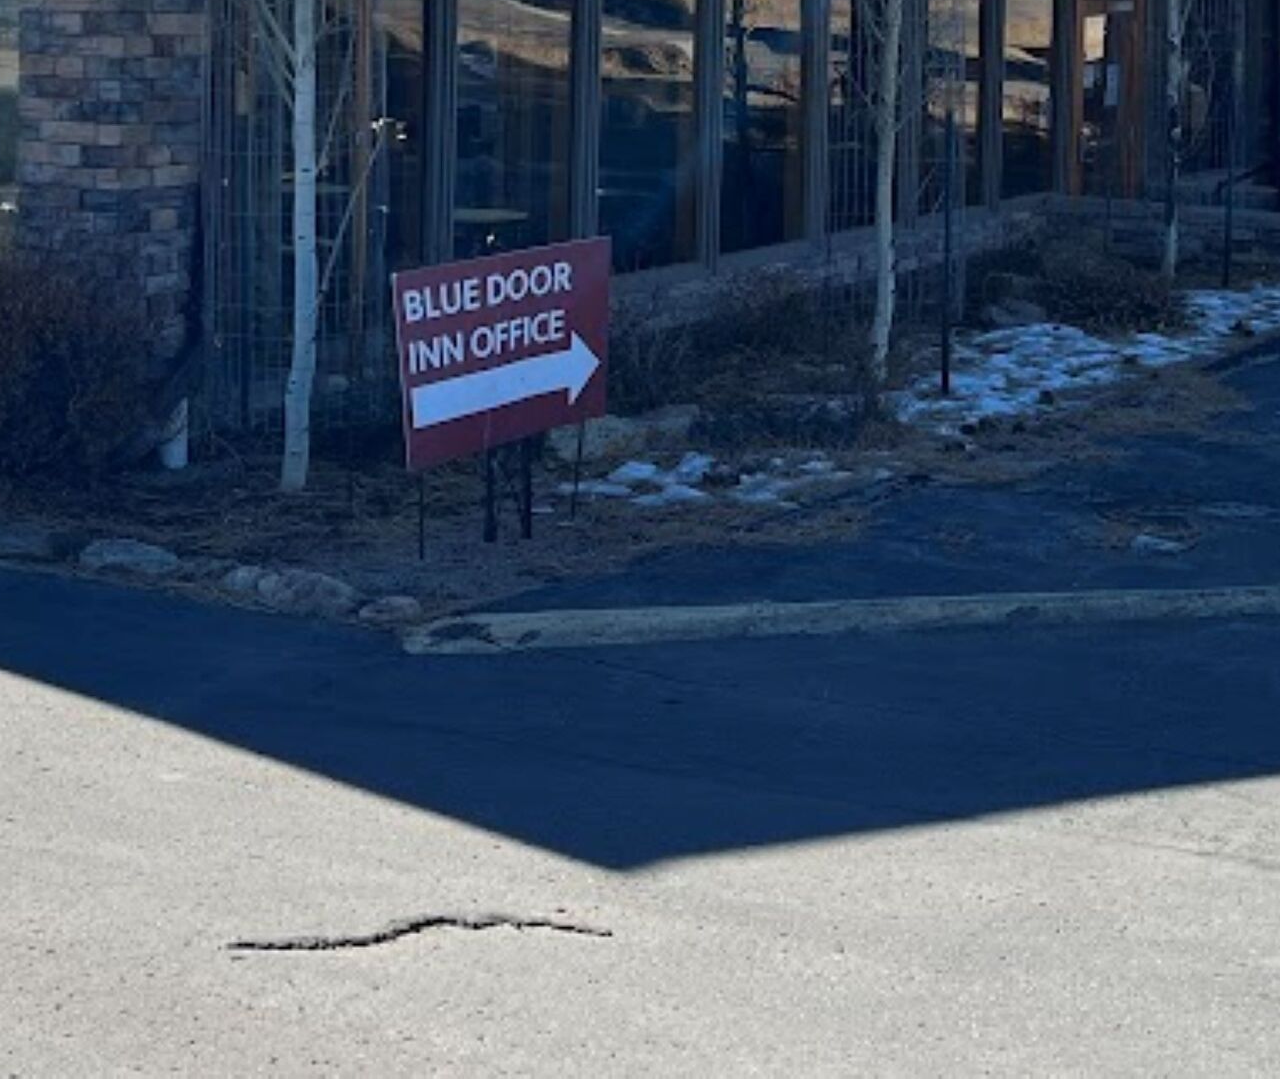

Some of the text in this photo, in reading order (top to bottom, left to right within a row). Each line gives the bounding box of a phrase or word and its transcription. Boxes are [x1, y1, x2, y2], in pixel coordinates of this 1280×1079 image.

[404, 262, 572, 322] BLUE DOOR
[409, 310, 566, 373] INN OFFICE
